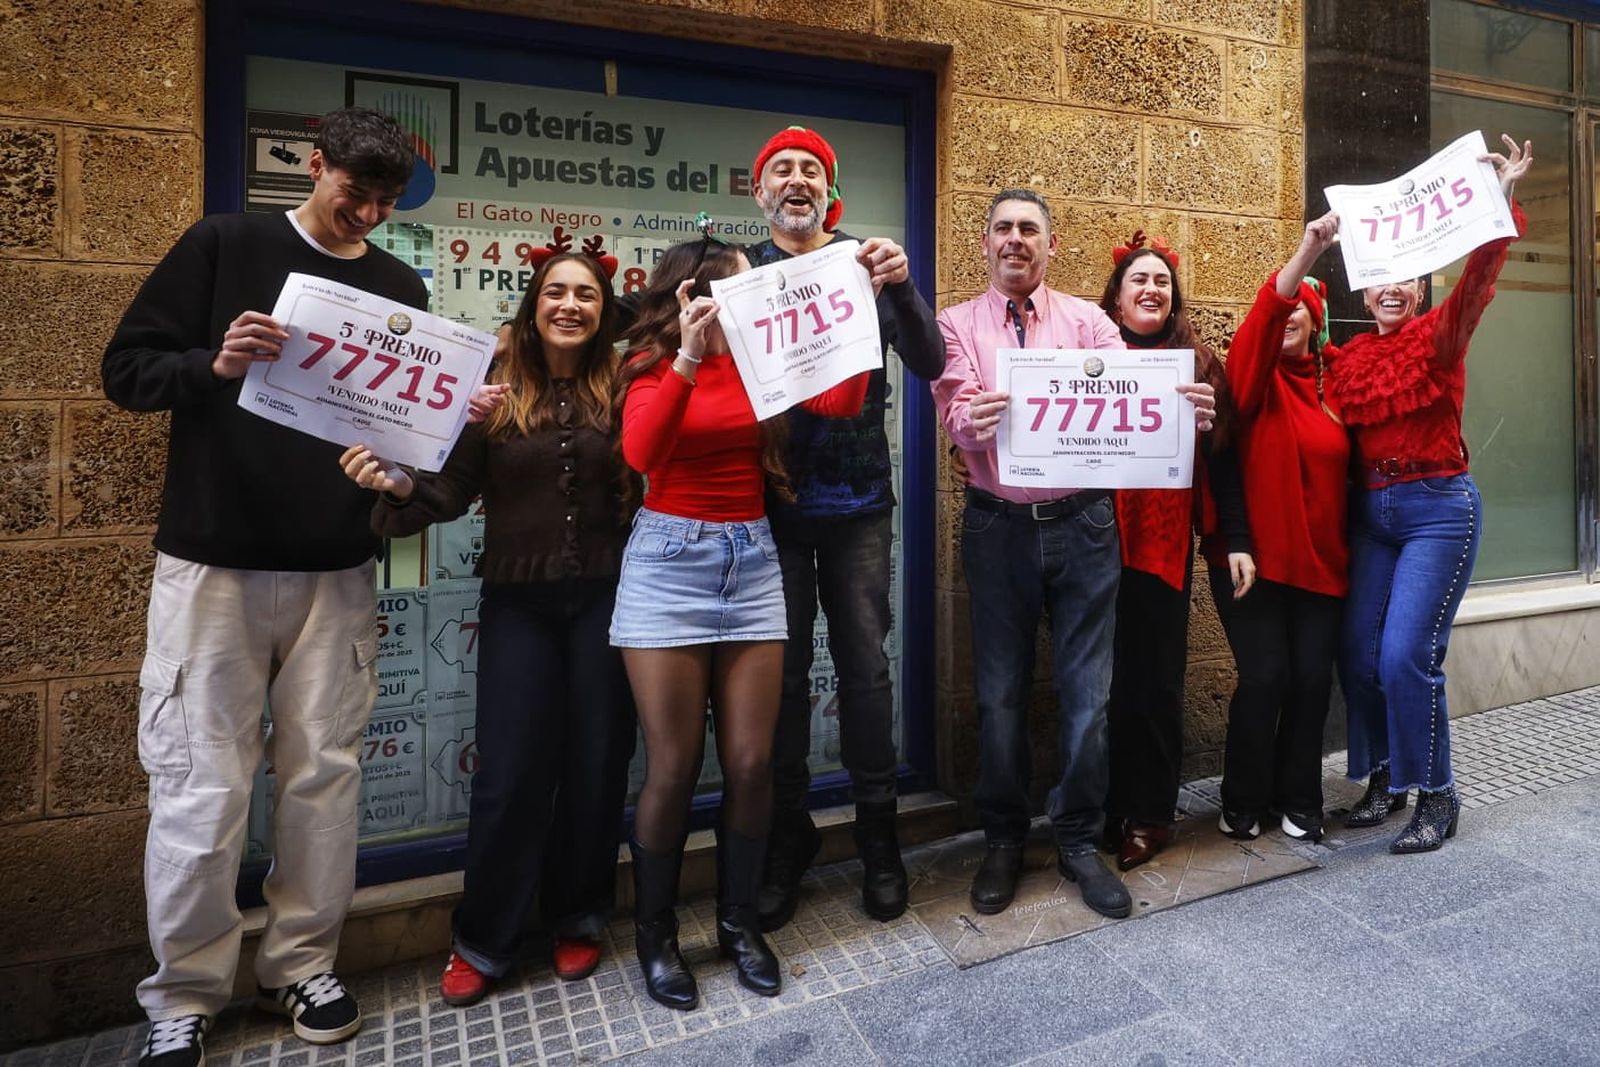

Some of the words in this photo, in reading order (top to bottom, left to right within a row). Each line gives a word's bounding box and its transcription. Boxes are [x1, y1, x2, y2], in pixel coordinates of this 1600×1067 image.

[475, 102, 634, 146] Loterías
[645, 126, 665, 156] y
[475, 147, 656, 190] Apuestas
[666, 161, 719, 194] del
[730, 168, 754, 197] E
[1389, 176, 1446, 211] PREMIO
[456, 203, 474, 220] El
[482, 204, 534, 223] Gato
[541, 208, 602, 231] Negro
[633, 213, 770, 237] Adminración
[1360, 177, 1474, 242] 77715
[364, 328, 442, 366] PREMIO
[298, 332, 458, 410] 77715
[328, 384, 379, 407] VENDIDO
[1069, 380, 1138, 394] PREMIO
[1026, 398, 1163, 433] 77715
[1058, 437, 1101, 446] VENDIDO
[394, 623, 406, 636] €
[377, 679, 406, 697] QUÍ
[378, 668, 420, 680] RIMITIVA
[363, 720, 407, 738] MIO
[402, 741, 414, 754] €
